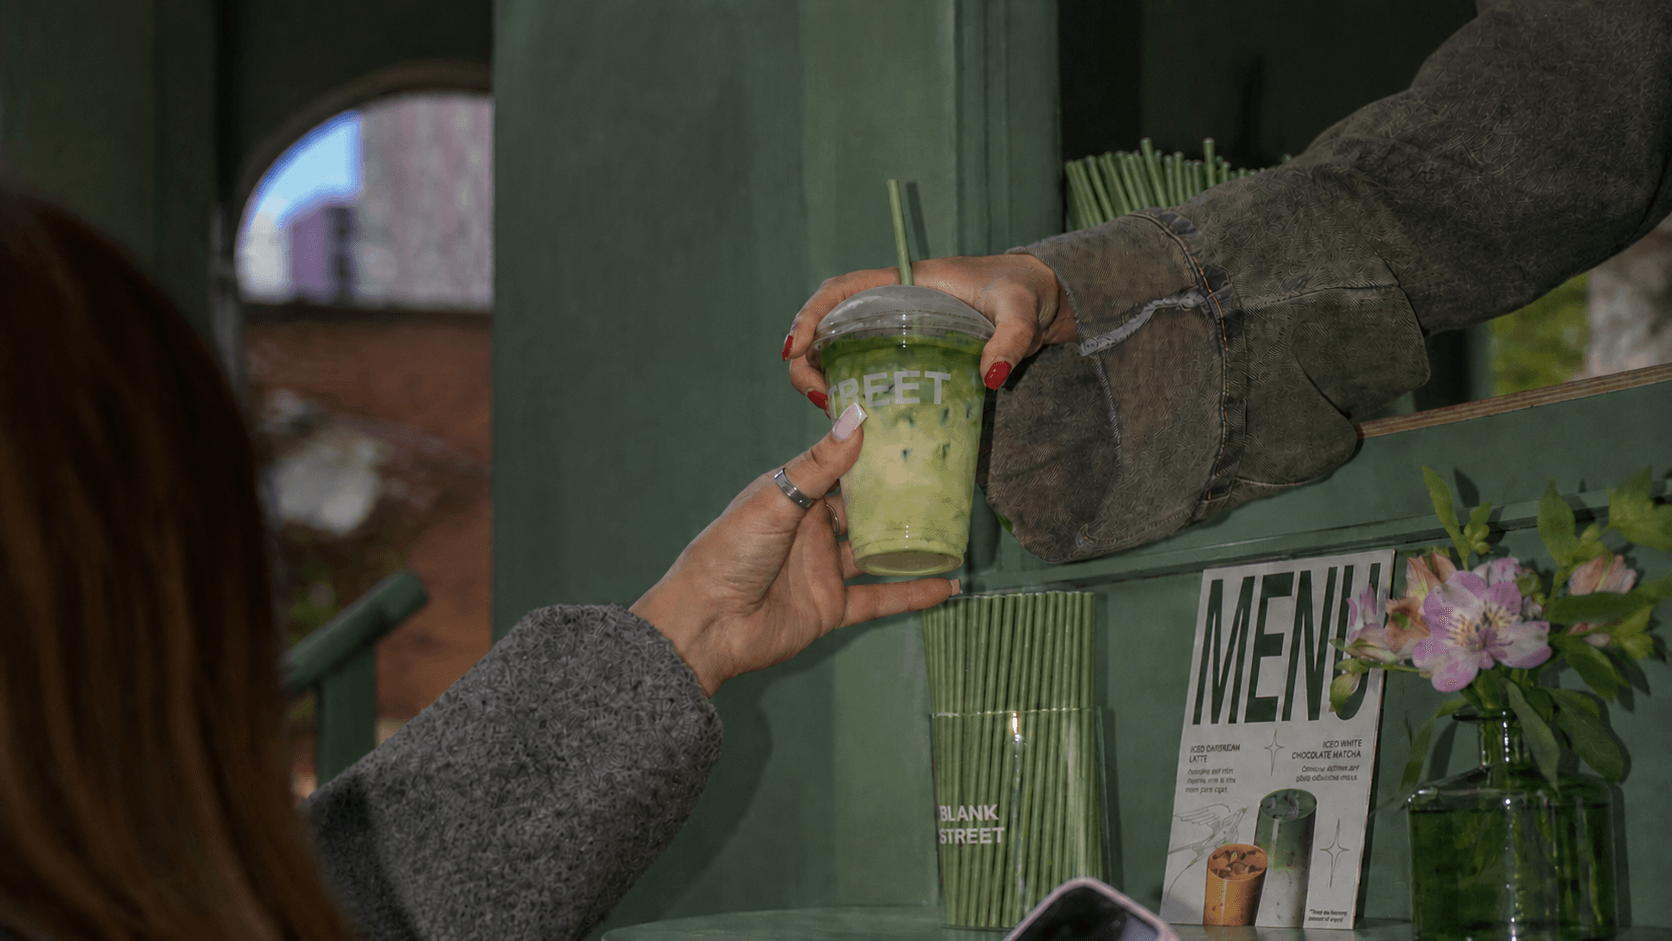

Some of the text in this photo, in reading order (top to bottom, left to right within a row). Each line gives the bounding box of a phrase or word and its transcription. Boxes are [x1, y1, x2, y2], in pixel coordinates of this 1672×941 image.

[1192, 563, 1381, 725] MENU
[1323, 739, 1362, 749] ICED WHITE
[1189, 754, 1208, 763] LATTE
[1291, 750, 1332, 760] CHOCOLATE
[939, 804, 999, 822] BLANK
[939, 827, 1005, 844] STREET
